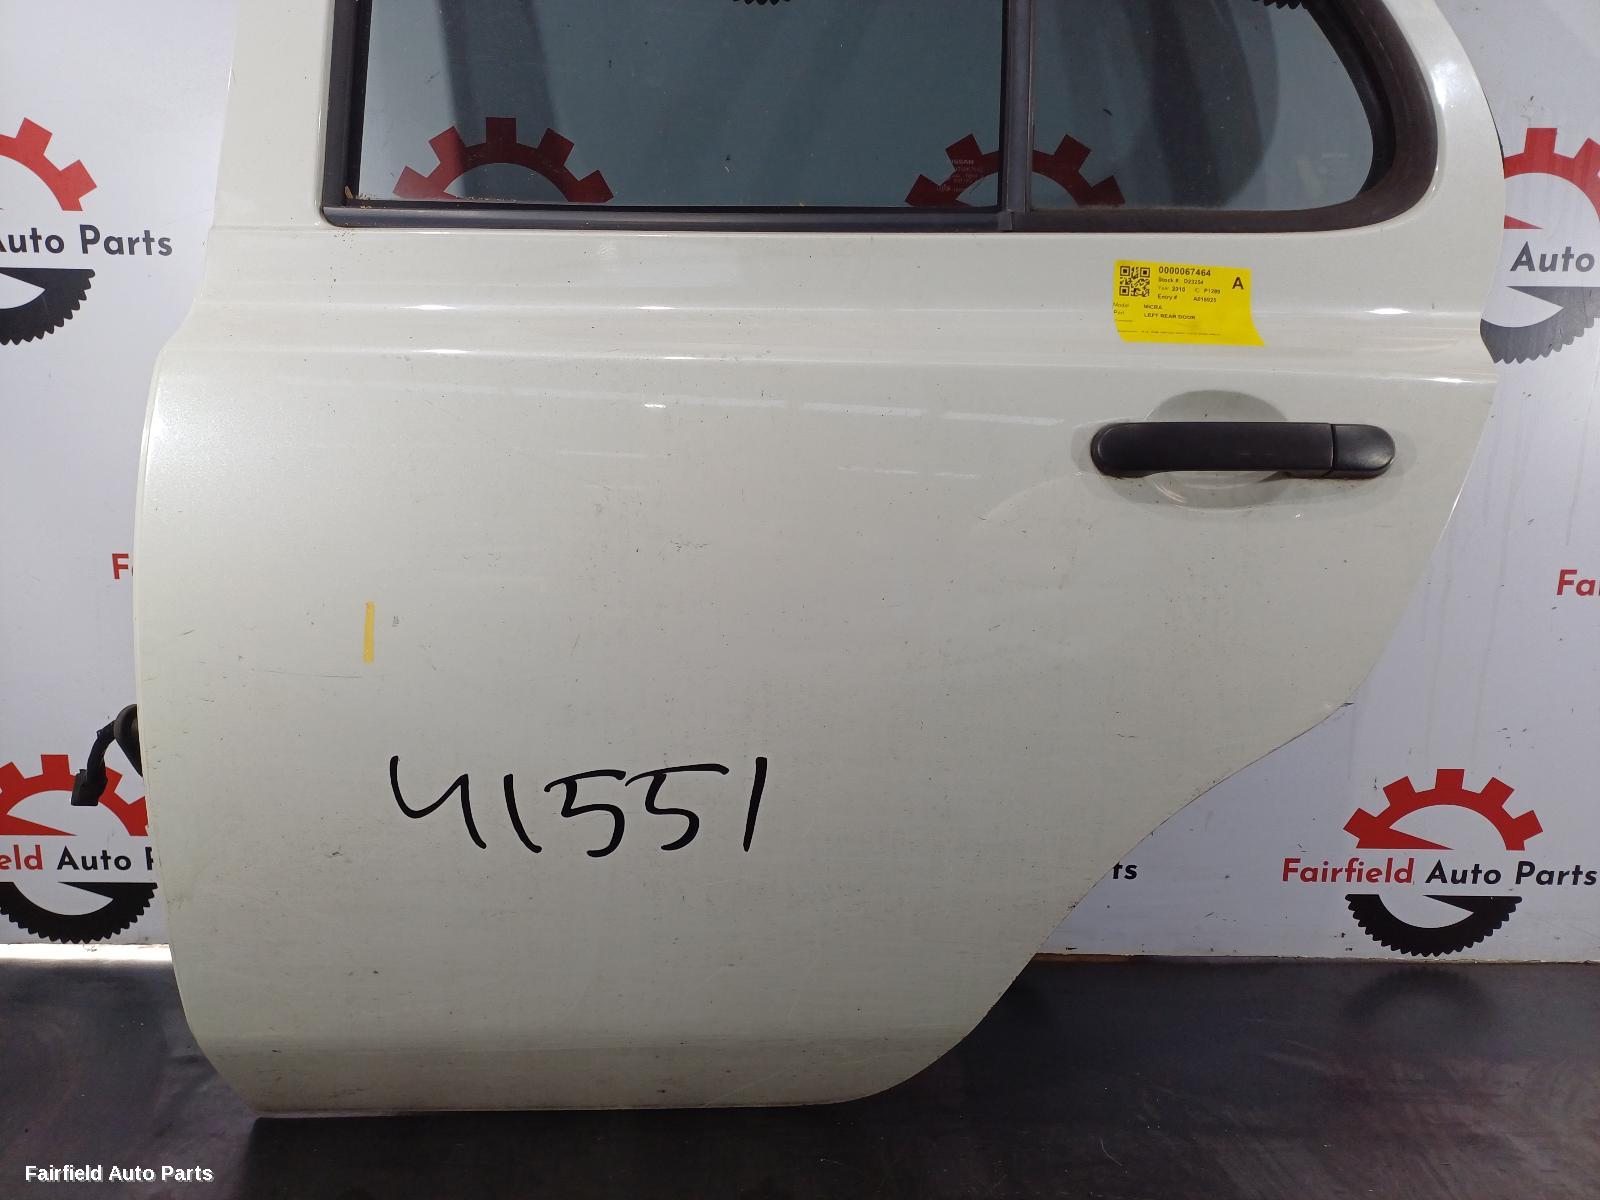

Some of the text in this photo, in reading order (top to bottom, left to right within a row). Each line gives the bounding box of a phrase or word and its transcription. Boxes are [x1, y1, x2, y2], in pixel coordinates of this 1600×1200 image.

[79, 224, 173, 256] Parts
[1510, 240, 1595, 273] Auto
[1158, 266, 1211, 277] 0000067464
[1232, 276, 1244, 290] A
[56, 845, 132, 871] Auto
[1282, 857, 1598, 886] Fairfield Auto Parts
